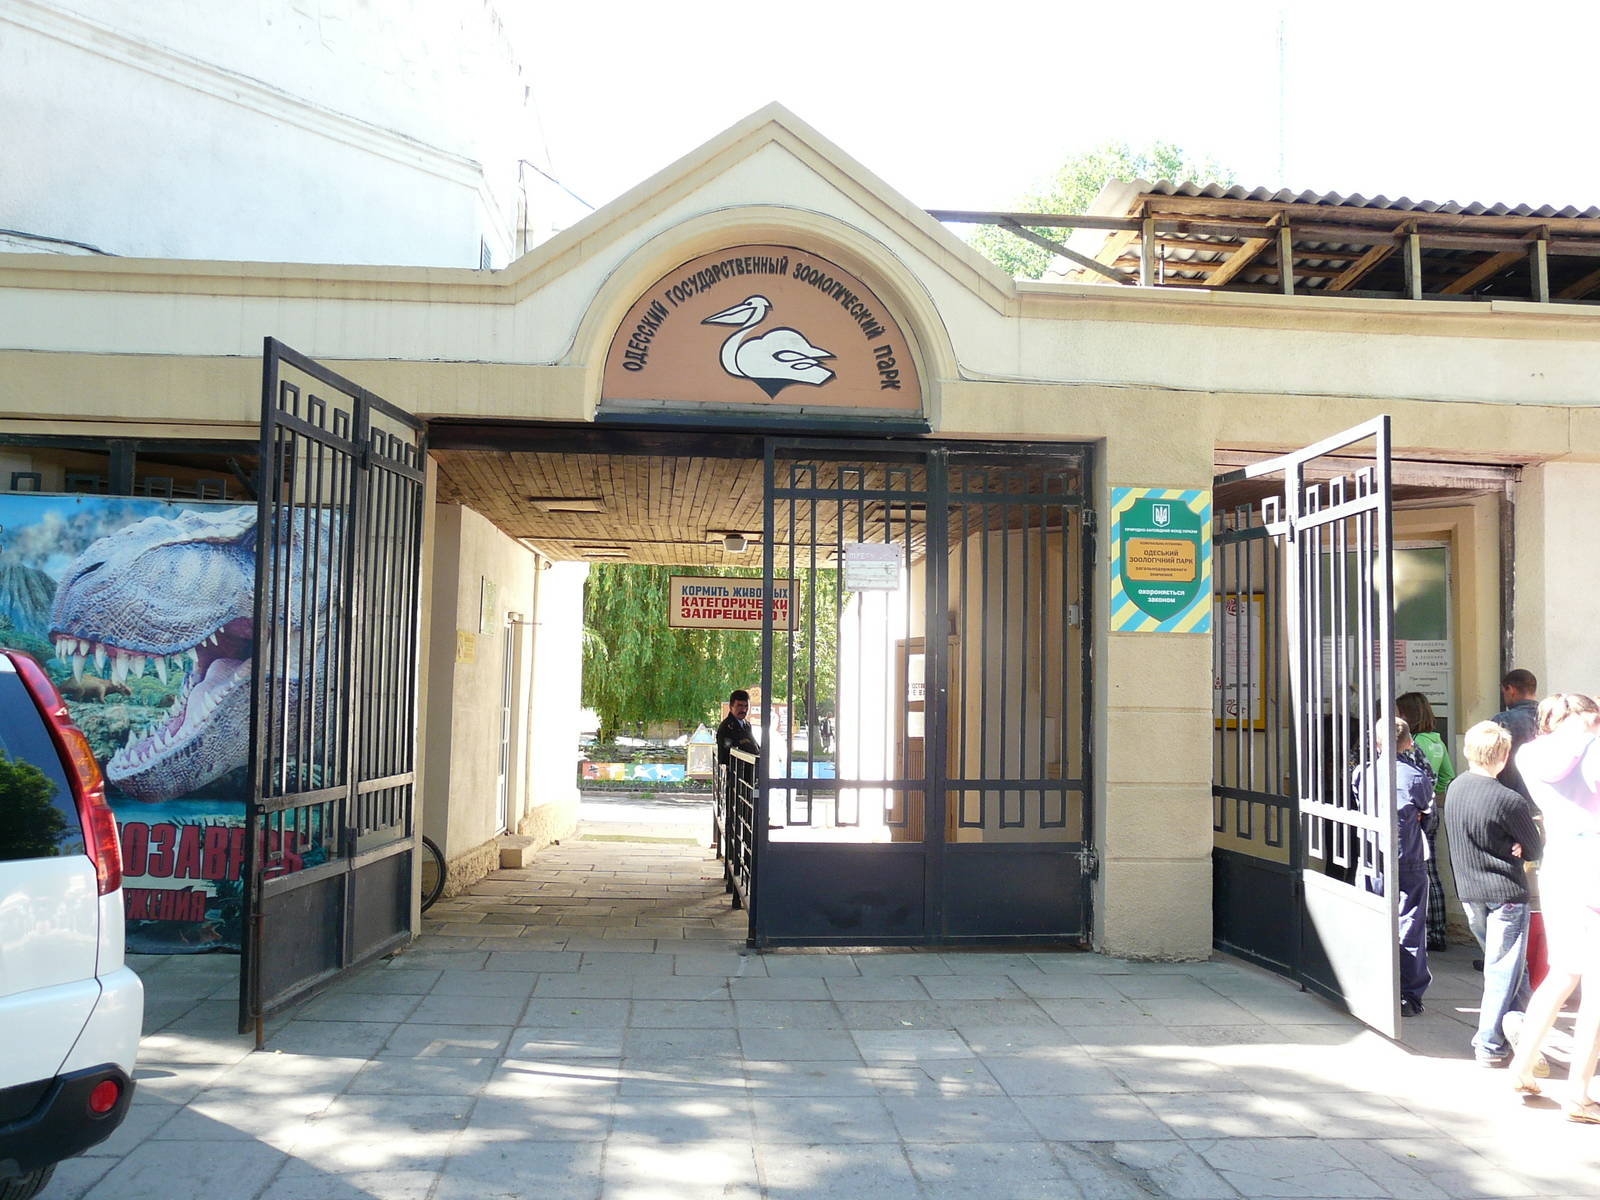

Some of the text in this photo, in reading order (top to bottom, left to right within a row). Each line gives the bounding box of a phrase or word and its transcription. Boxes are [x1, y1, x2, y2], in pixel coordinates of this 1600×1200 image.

[622, 299, 670, 373] ОДЕССКИЙ
[792, 262, 887, 341] ЗООЛОГИЧЕСКИЙ
[1143, 549, 1179, 557] ОДЕСЬКИЙ
[1129, 556, 1194, 565] ЗООЛОГІЧНИЙ ПАРК
[681, 585, 788, 599] КОРМИТЬ ЖИВОЫХ
[681, 597, 788, 610] КАТЕГОРИЧЕКИ
